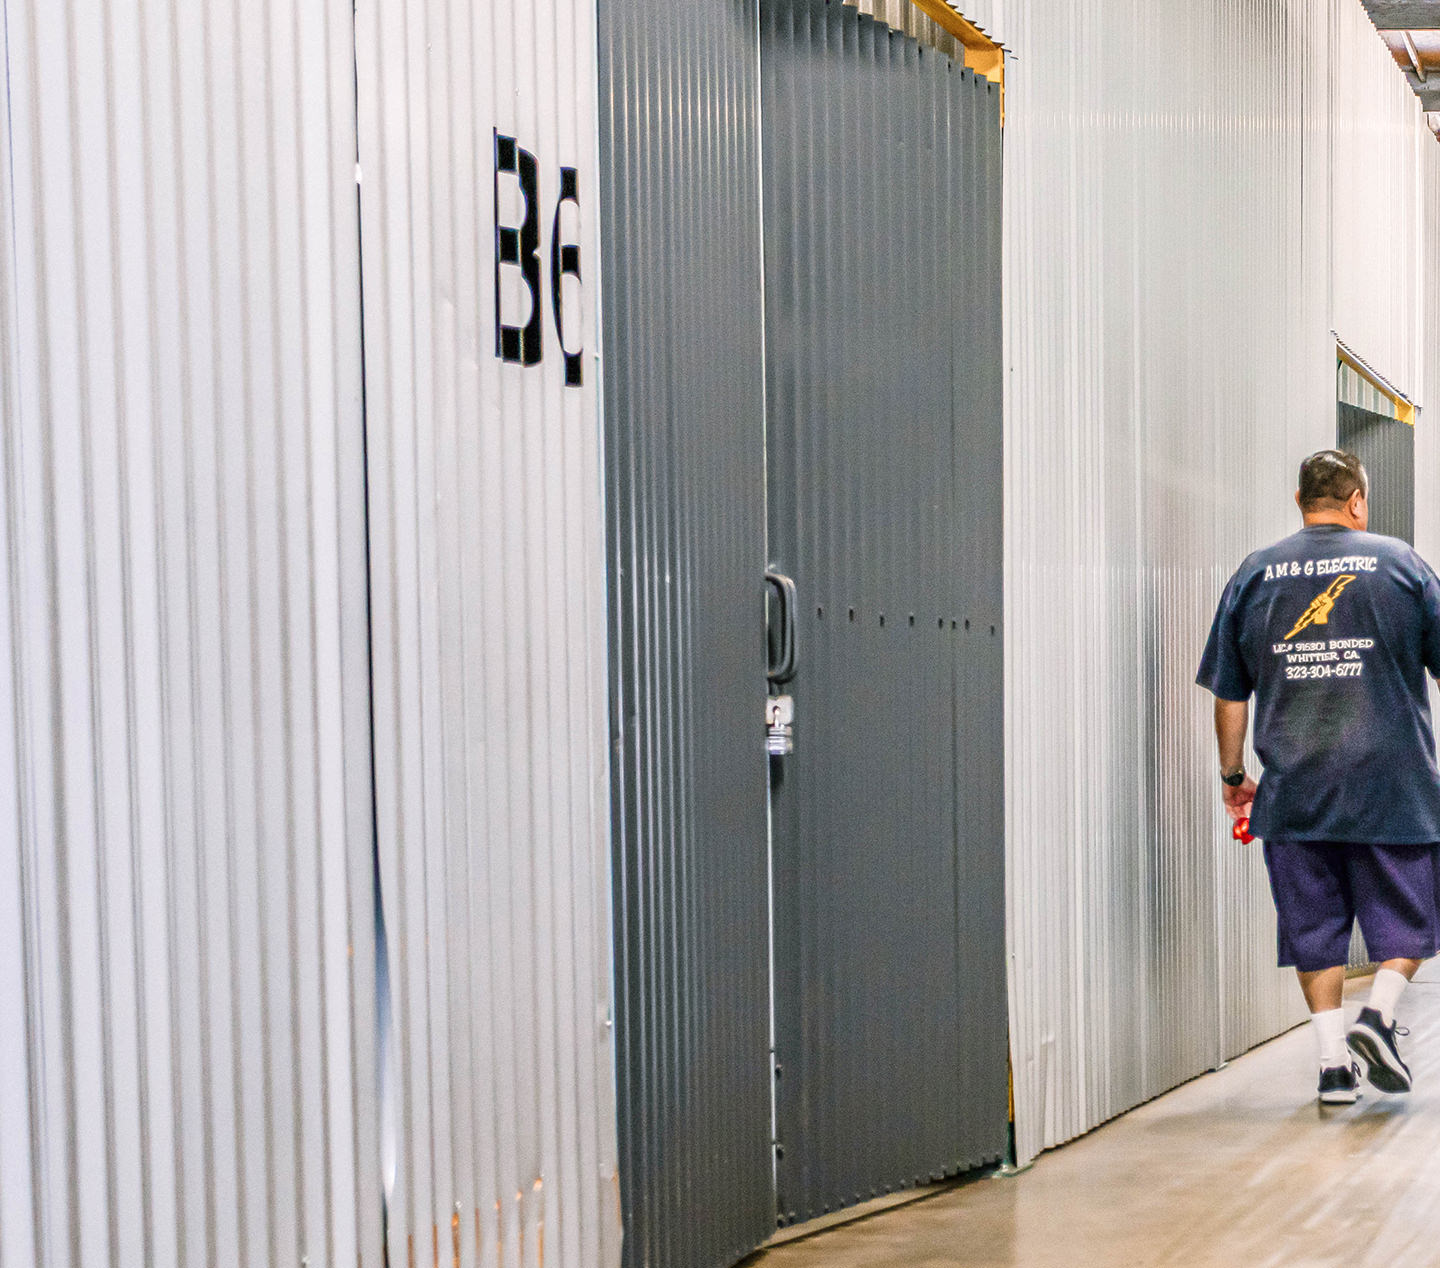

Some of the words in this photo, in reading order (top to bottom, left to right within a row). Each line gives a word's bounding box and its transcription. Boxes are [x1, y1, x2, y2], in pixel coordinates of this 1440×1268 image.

[1290, 561, 1302, 576] &
[1304, 560, 1314, 576] G
[1316, 556, 1377, 575] ELECTRIC
[1329, 639, 1374, 650] BONDED
[1285, 662, 1363, 679] 323-304-6777
